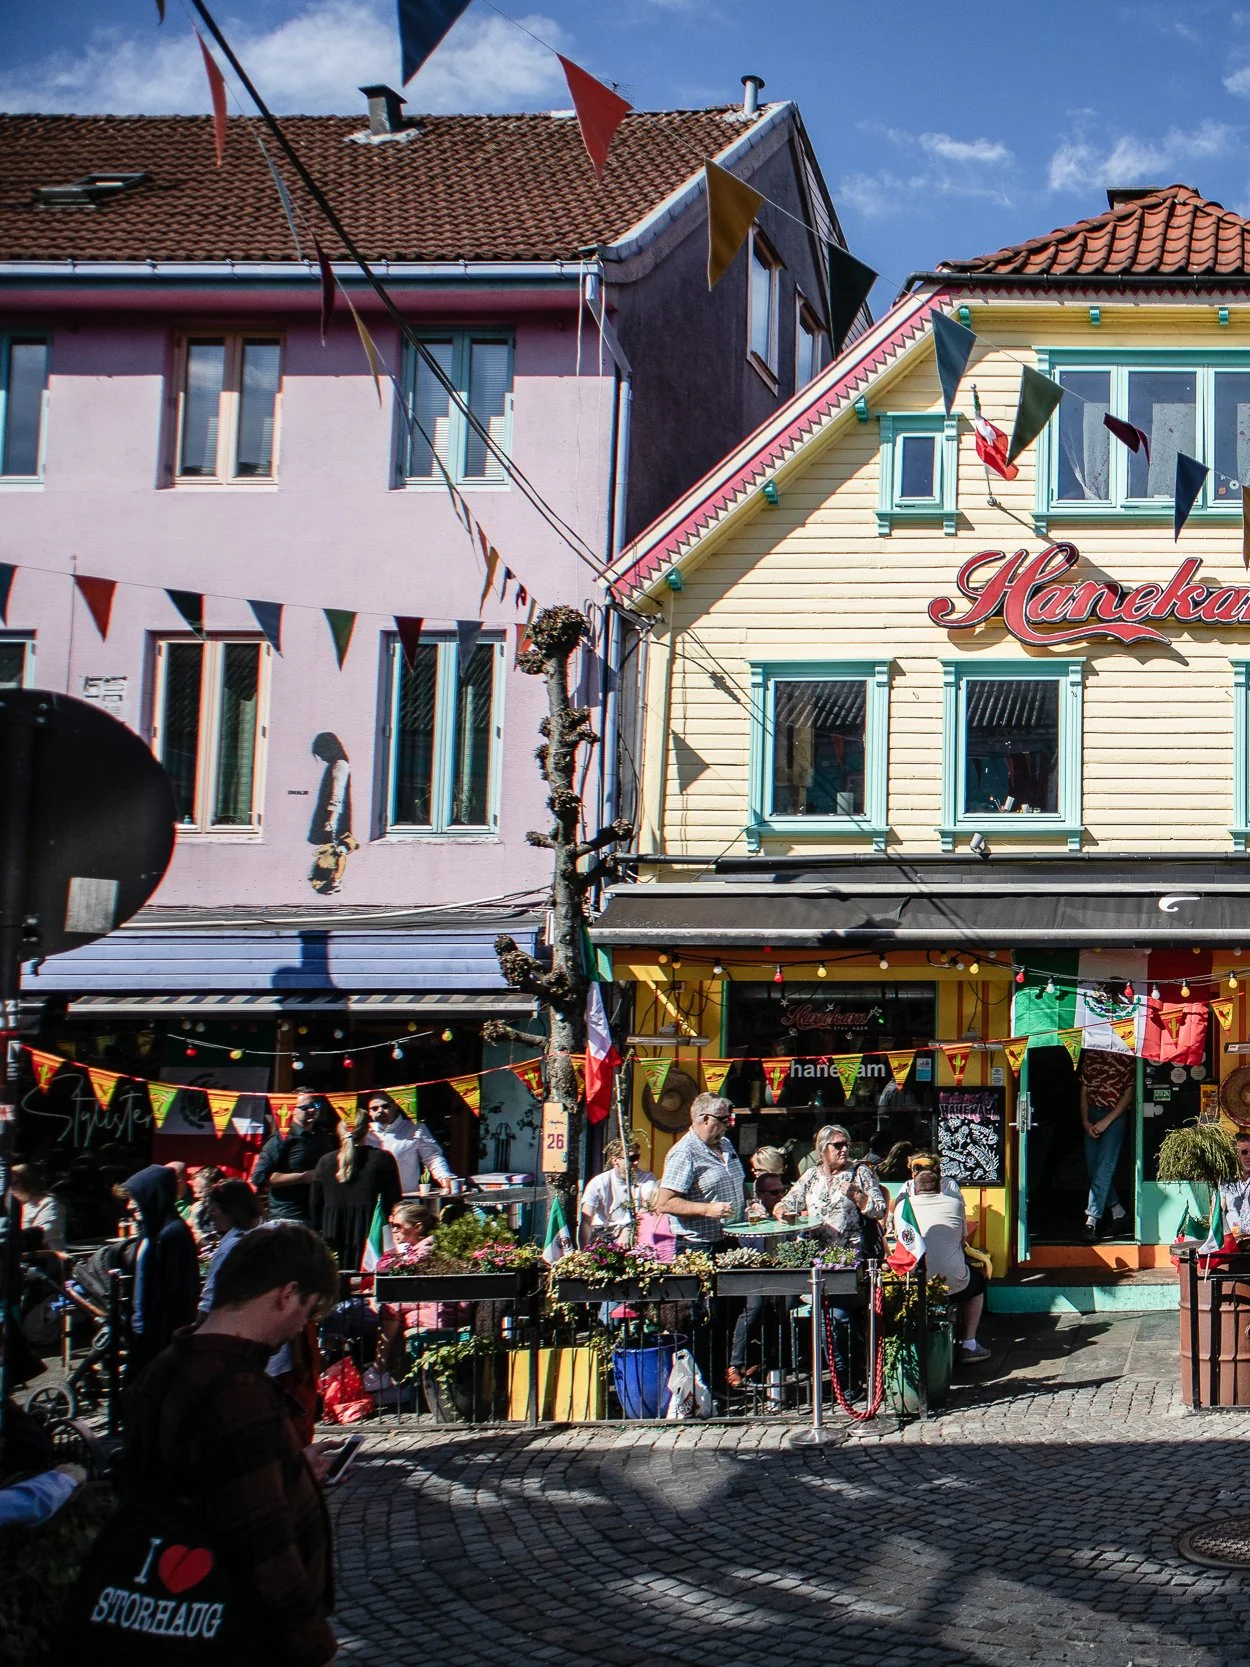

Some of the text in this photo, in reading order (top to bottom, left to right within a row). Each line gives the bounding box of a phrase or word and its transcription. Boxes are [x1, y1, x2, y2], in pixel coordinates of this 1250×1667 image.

[790, 1060, 886, 1078] haneam
[547, 1133, 564, 1150] 26
[134, 1537, 162, 1584] I
[90, 1586, 226, 1639] STORHAUG
